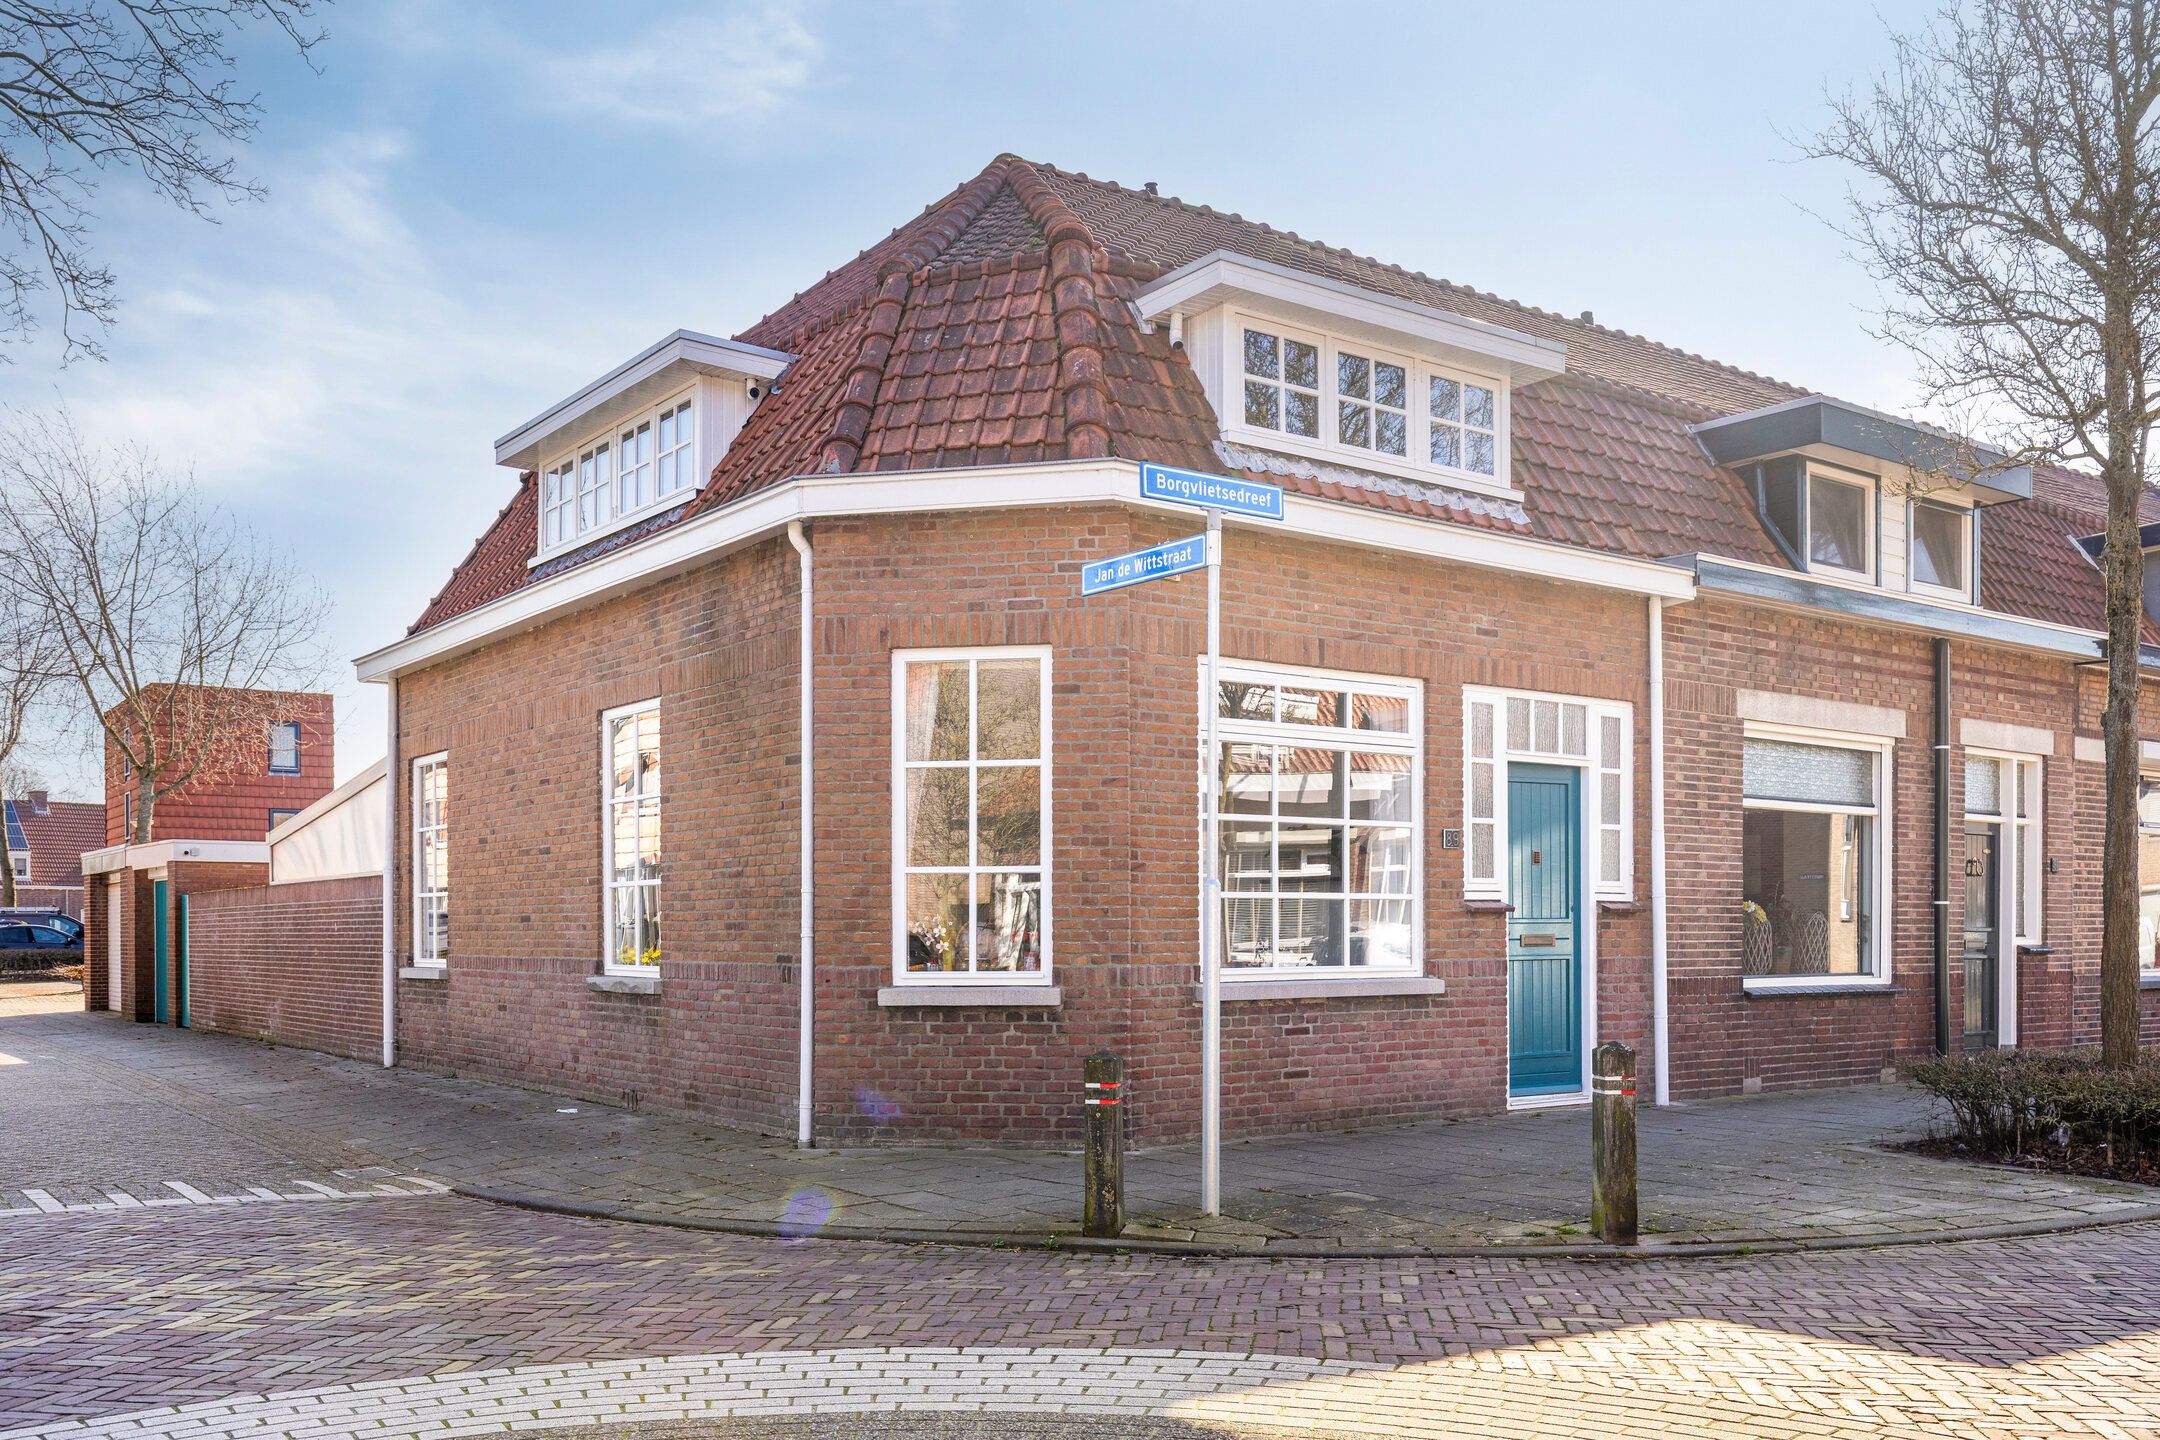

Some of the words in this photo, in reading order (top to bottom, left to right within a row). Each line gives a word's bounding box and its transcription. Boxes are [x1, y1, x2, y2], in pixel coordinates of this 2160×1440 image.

[1156, 473, 1272, 508] Borgvlietsedreef
[1094, 568, 1114, 583] Jan
[1118, 562, 1130, 577] de
[1134, 545, 1192, 573] Wittstraat
[1446, 832, 1459, 846] 89
